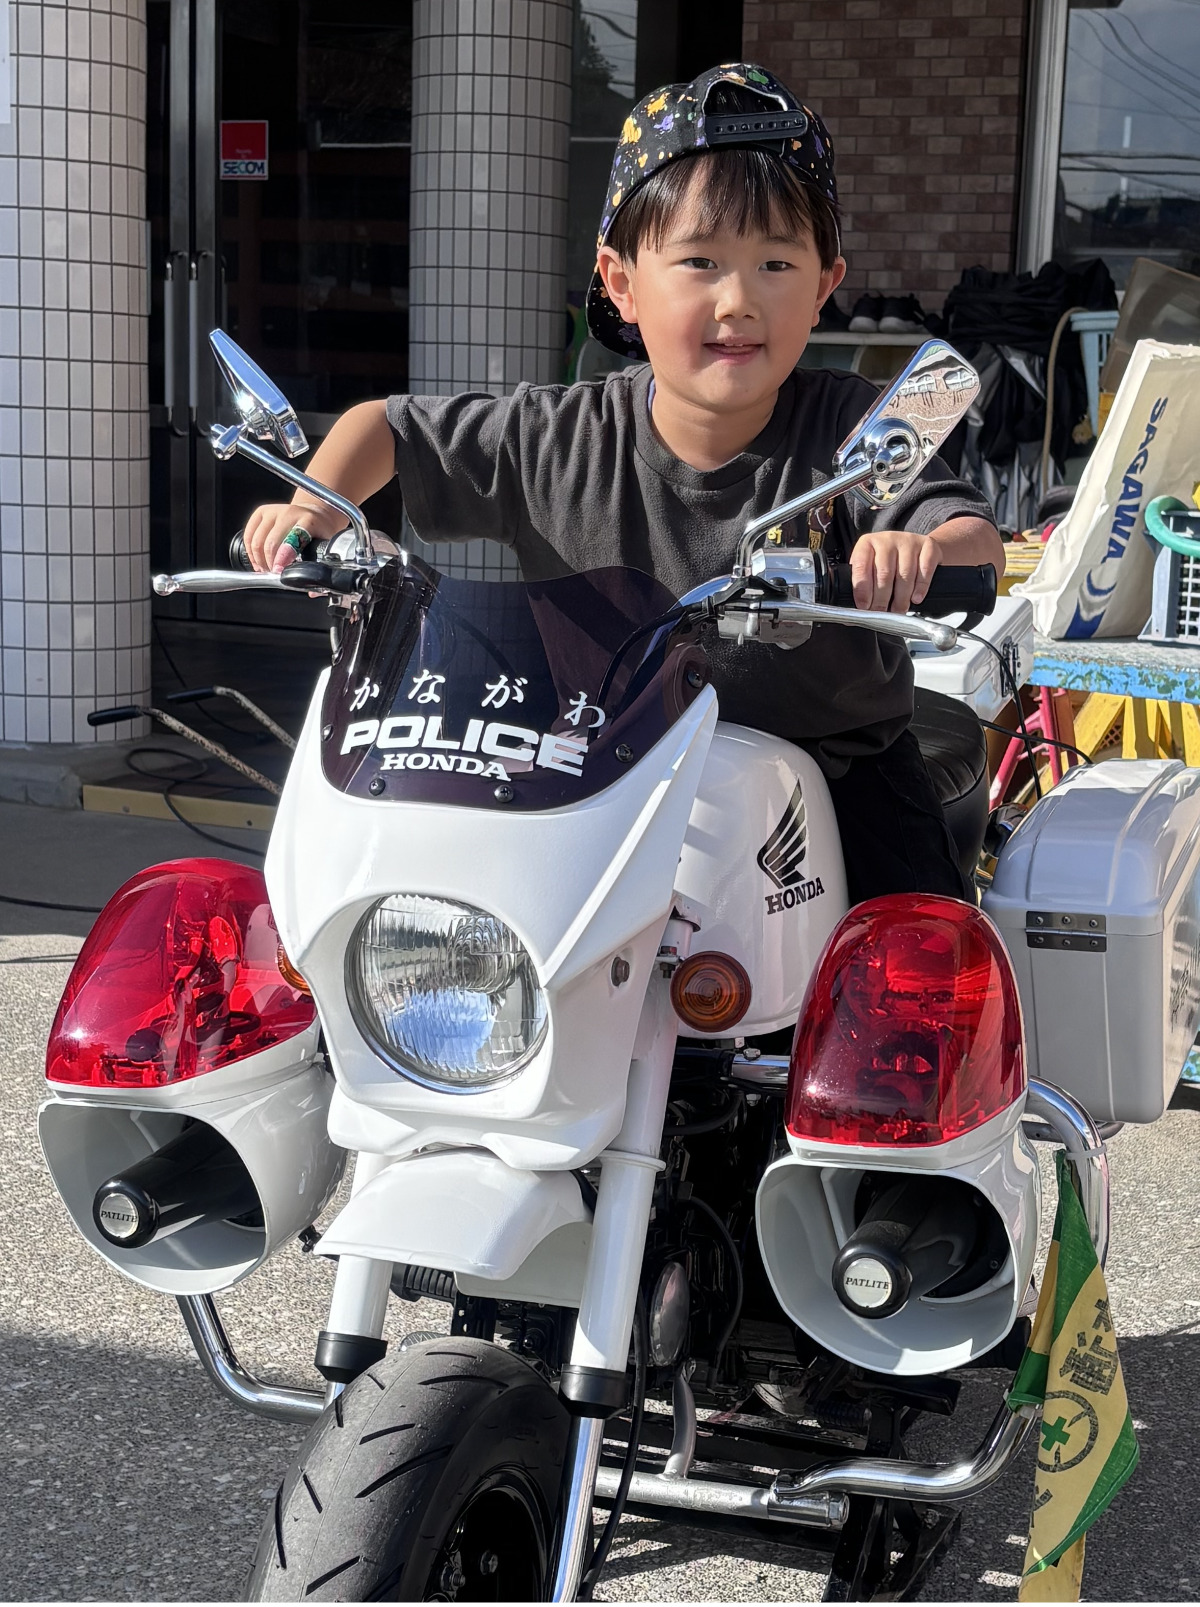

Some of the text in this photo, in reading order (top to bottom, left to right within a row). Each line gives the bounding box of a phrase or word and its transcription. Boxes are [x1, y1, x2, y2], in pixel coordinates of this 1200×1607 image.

[223, 161, 265, 174] SECOM
[1101, 397, 1169, 564] SAGAWA
[350, 669, 606, 728] かながわ
[340, 716, 589, 778] POLICE
[380, 753, 512, 782] HONDA
[764, 877, 825, 915] HONDA
[100, 1210, 138, 1223] PATLITE
[845, 1277, 890, 1290] PATLITE
